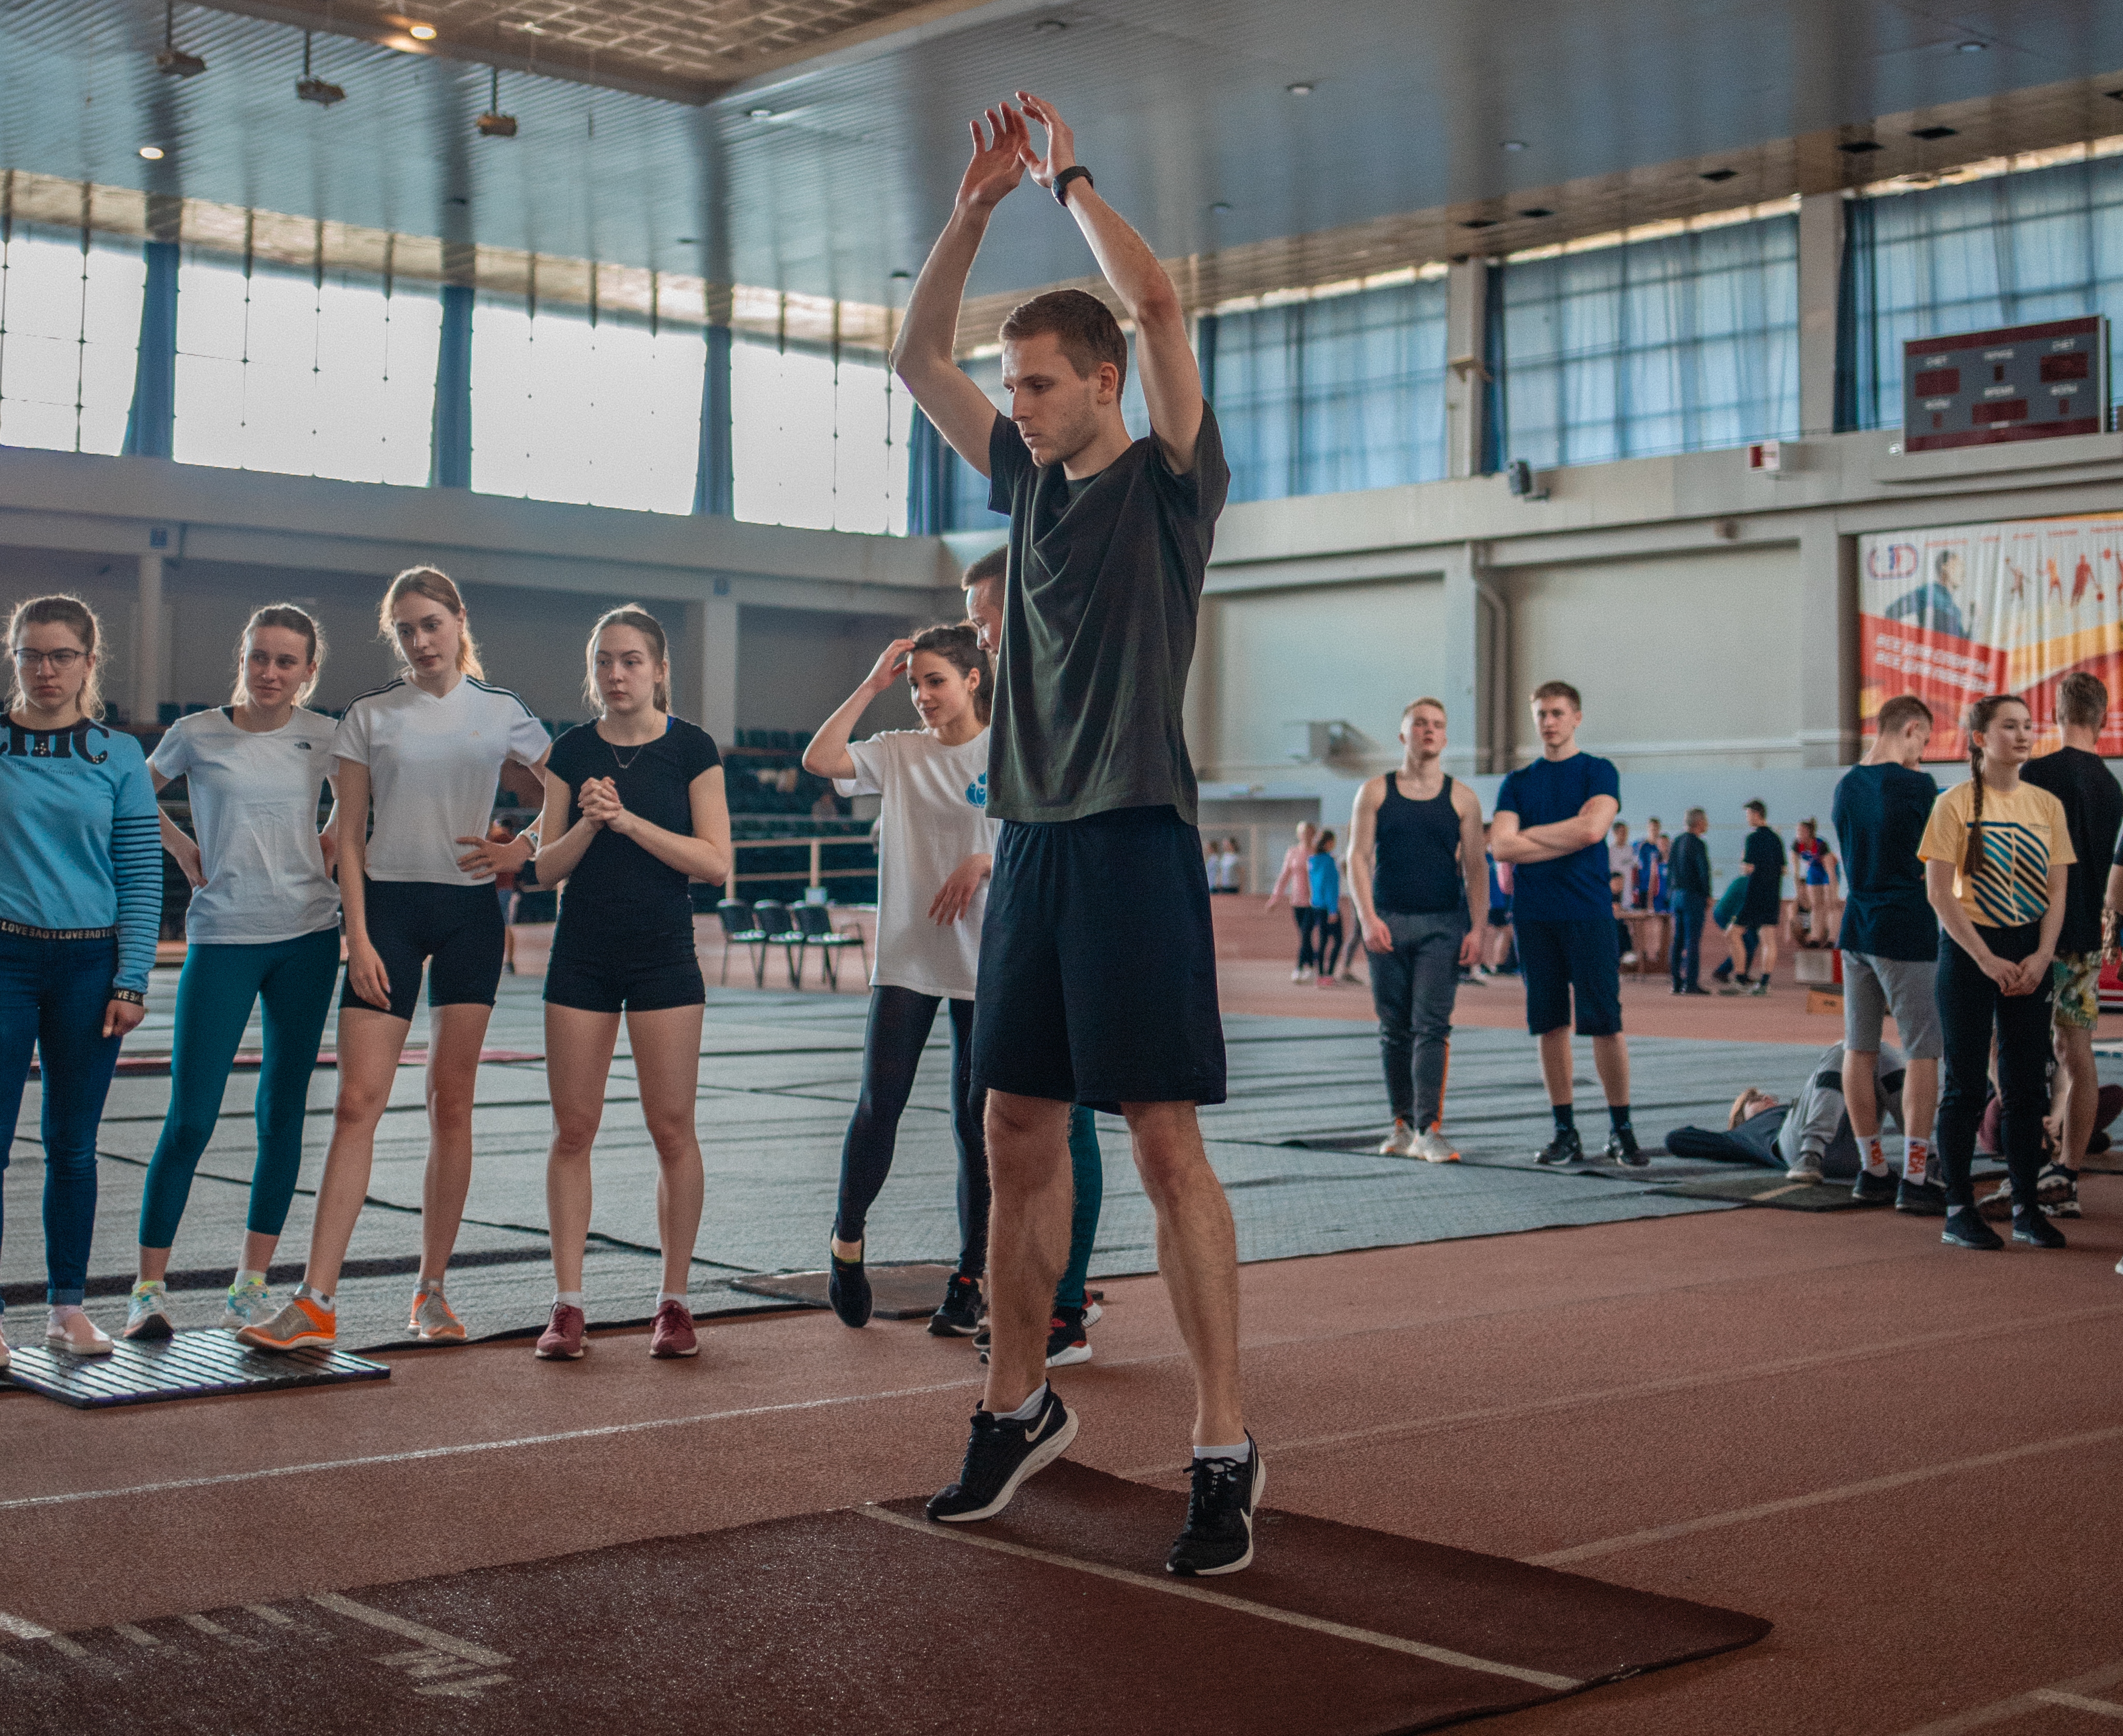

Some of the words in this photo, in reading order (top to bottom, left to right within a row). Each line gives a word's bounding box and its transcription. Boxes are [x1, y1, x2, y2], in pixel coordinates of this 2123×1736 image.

[0, 719, 110, 764] HIC
[2, 921, 28, 935] LOVE
[58, 930, 83, 940] LOVE
[1908, 1145, 1927, 1174] NBA
